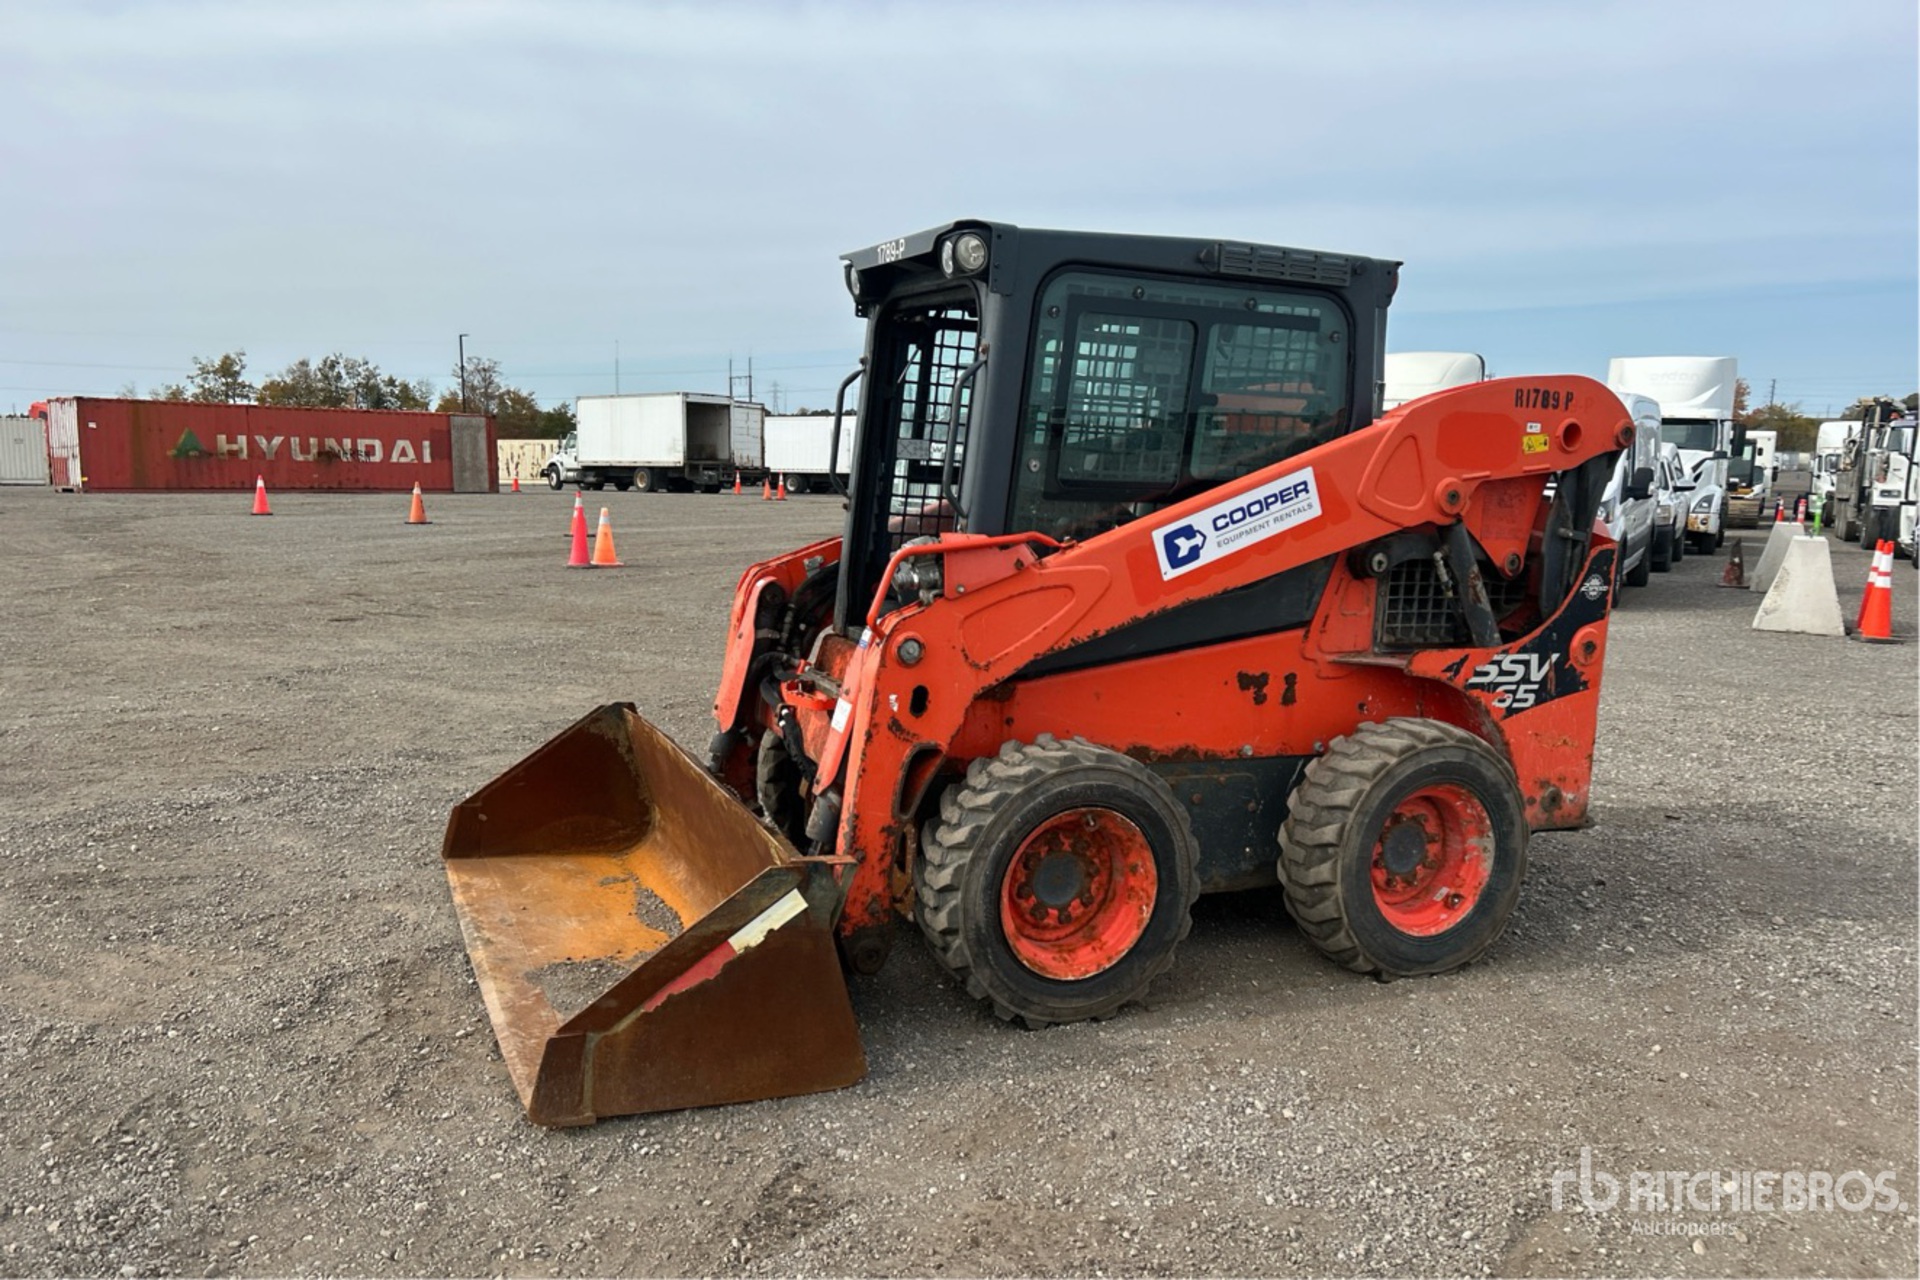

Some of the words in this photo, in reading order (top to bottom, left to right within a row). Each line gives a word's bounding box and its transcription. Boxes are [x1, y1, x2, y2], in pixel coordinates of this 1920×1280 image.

[877, 238, 905, 264] 1789-P
[1564, 390, 1574, 411] P
[216, 434, 432, 463] HYUNDAI
[1212, 480, 1310, 532] COOPER
[1216, 520, 1272, 548] EQUIPMENT
[1273, 502, 1314, 525] RENTALS
[1467, 653, 1560, 684] SSV
[1492, 684, 1539, 708] 65
